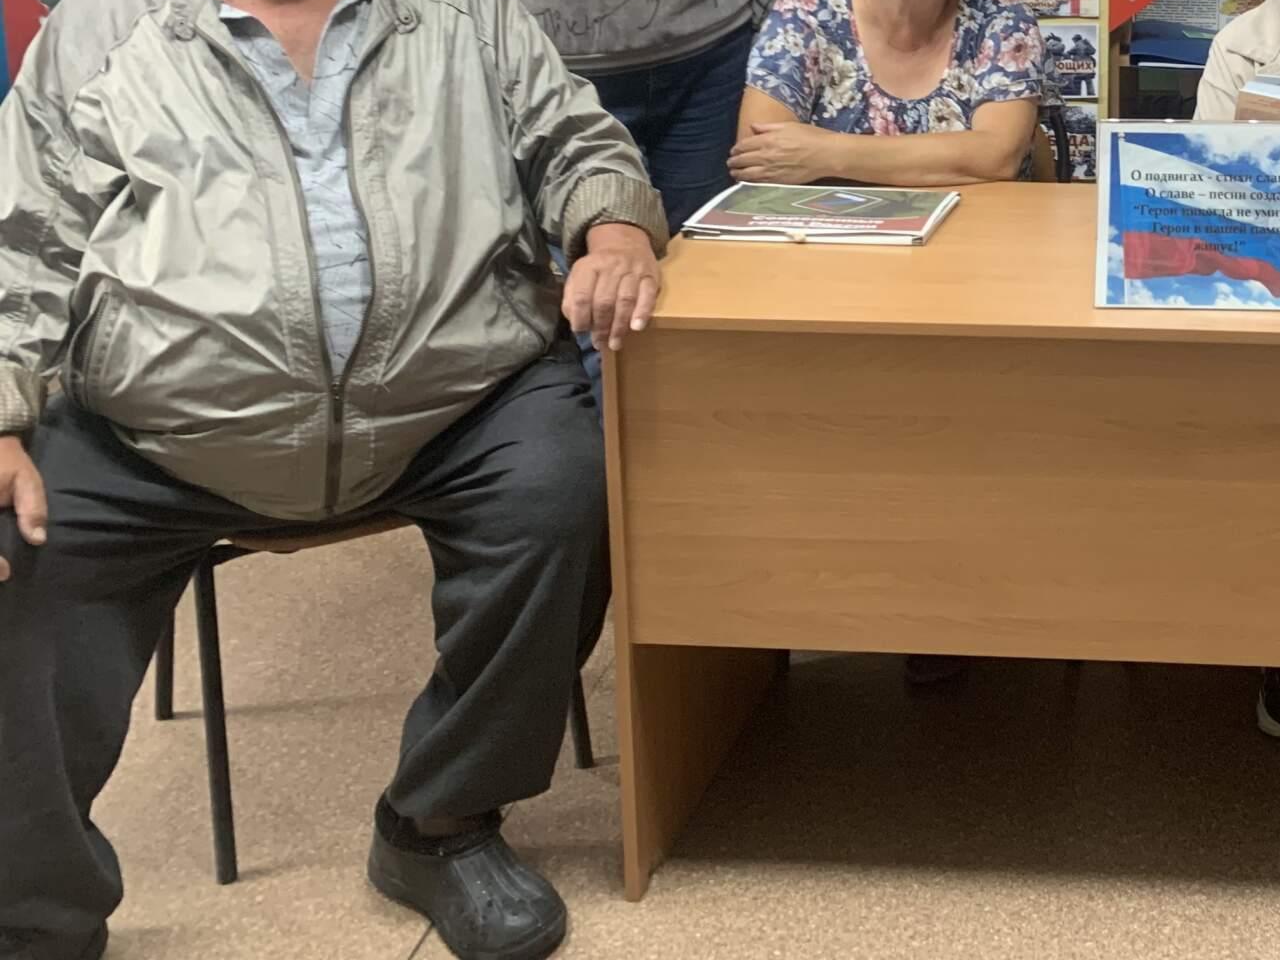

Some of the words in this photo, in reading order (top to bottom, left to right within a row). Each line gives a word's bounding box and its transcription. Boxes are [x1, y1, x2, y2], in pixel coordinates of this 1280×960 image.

[1130, 169, 1142, 181] О
[1145, 171, 1204, 183] подвигах
[1144, 187, 1156, 199] О
[1158, 190, 1196, 199] славе
[1209, 190, 1247, 200] песни
[1181, 207, 1233, 219] никогда
[1236, 208, 1251, 217] не
[1152, 222, 1191, 235] Герои
[1193, 225, 1201, 234] в
